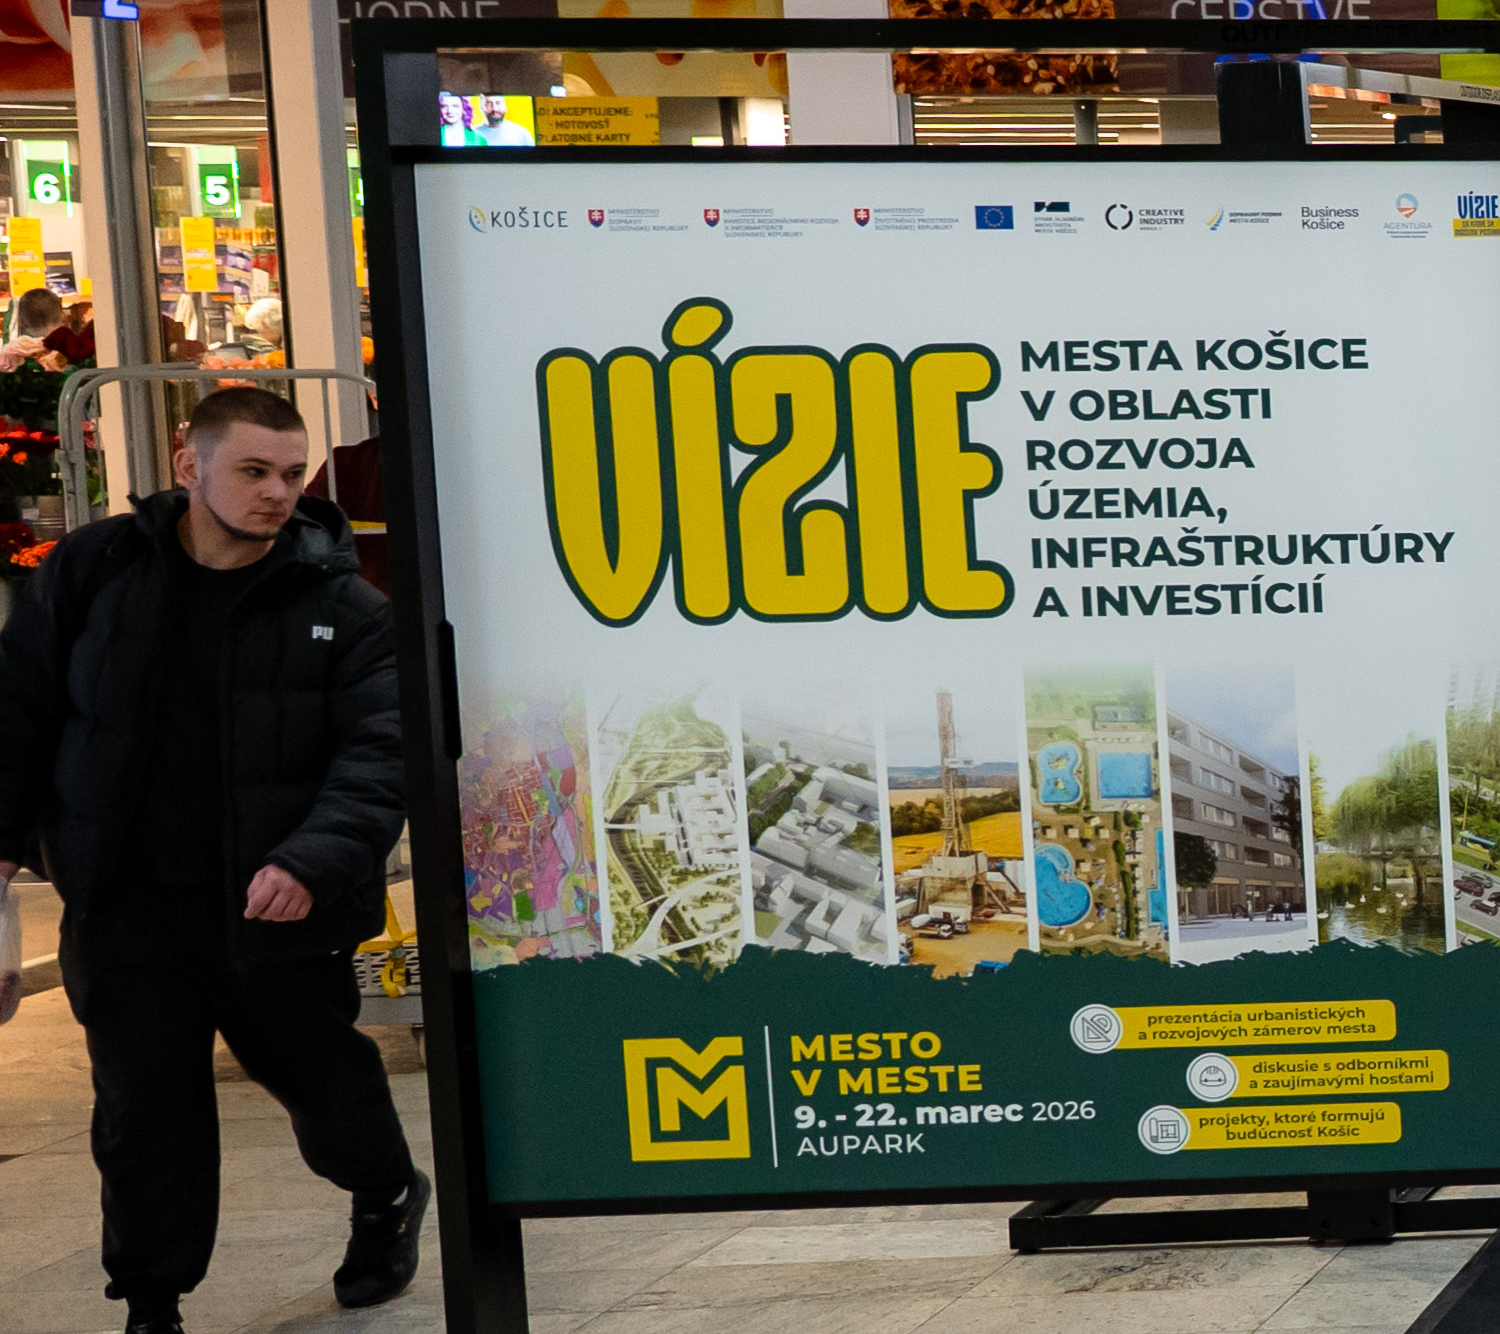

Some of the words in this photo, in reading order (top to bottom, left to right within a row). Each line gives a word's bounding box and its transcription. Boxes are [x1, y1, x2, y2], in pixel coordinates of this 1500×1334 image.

[33, 172, 61, 204] 6
[205, 174, 231, 205] 5
[490, 207, 568, 229] KOŠICE
[1301, 206, 1359, 218] Business
[1302, 218, 1345, 229] Košice
[1020, 340, 1183, 372] MESTA
[1195, 329, 1369, 371] KOŠICE
[1021, 389, 1053, 421] V
[1069, 386, 1271, 421] OBLASTI
[1026, 436, 1254, 470] ROZVOJA
[1027, 475, 1228, 524] ÚZEMIA,
[1030, 523, 1455, 569] INFRAŠTRUKTÚRY
[1033, 584, 1067, 617] A
[1082, 573, 1324, 616] INVESTÍCIÍ
[1138, 1031, 1148, 1041] a
[1152, 1025, 1248, 1041] rozvojových
[1253, 1022, 1322, 1038] zámerov
[1326, 1022, 1376, 1035] mesta
[1148, 1009, 1242, 1027] prezentácia
[1247, 1006, 1366, 1024] urbanistických
[791, 1032, 942, 1063] MESTO
[791, 1069, 822, 1097] V
[839, 1063, 983, 1095] MESTE
[1252, 1058, 1319, 1074] diskusie
[1323, 1062, 1332, 1071] s
[1336, 1056, 1429, 1071] odborníkmi
[1249, 1080, 1258, 1089] a
[1262, 1073, 1365, 1091] zaujímavými
[1370, 1072, 1435, 1086] hosťami
[795, 1104, 829, 1129] 9.
[852, 1101, 908, 1127] 22.
[915, 1099, 1024, 1126] marec
[1031, 1098, 1096, 1123] 2026
[1199, 1110, 1270, 1128] projekty,
[1274, 1110, 1317, 1125] ktoré
[1320, 1108, 1385, 1126] formujú
[796, 1131, 925, 1158] AUPARK
[1226, 1126, 1313, 1142] budúcnosť
[1317, 1122, 1361, 1139] Košíc
